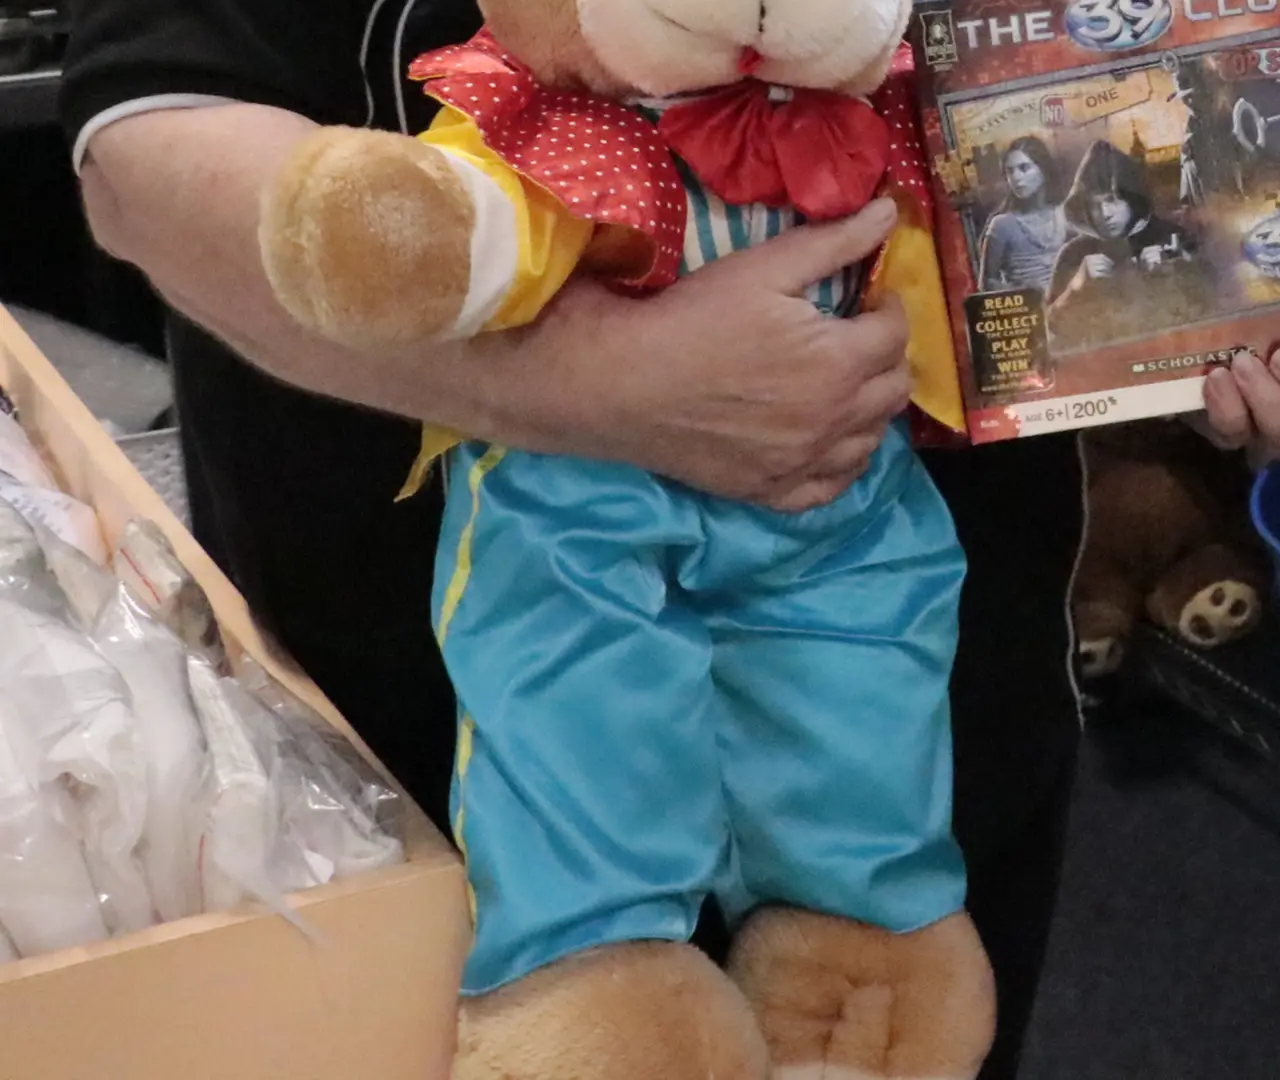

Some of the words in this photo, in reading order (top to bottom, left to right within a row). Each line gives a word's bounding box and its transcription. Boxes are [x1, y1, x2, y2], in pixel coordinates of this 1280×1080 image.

[956, 10, 1055, 50] THE
[1085, 87, 1120, 109] ONE
[984, 295, 1024, 310] READ
[975, 314, 1039, 333] COLLECT
[991, 338, 1028, 353] PLAY
[997, 358, 1029, 373] WIN
[1147, 346, 1257, 372] SCHOLASTC
